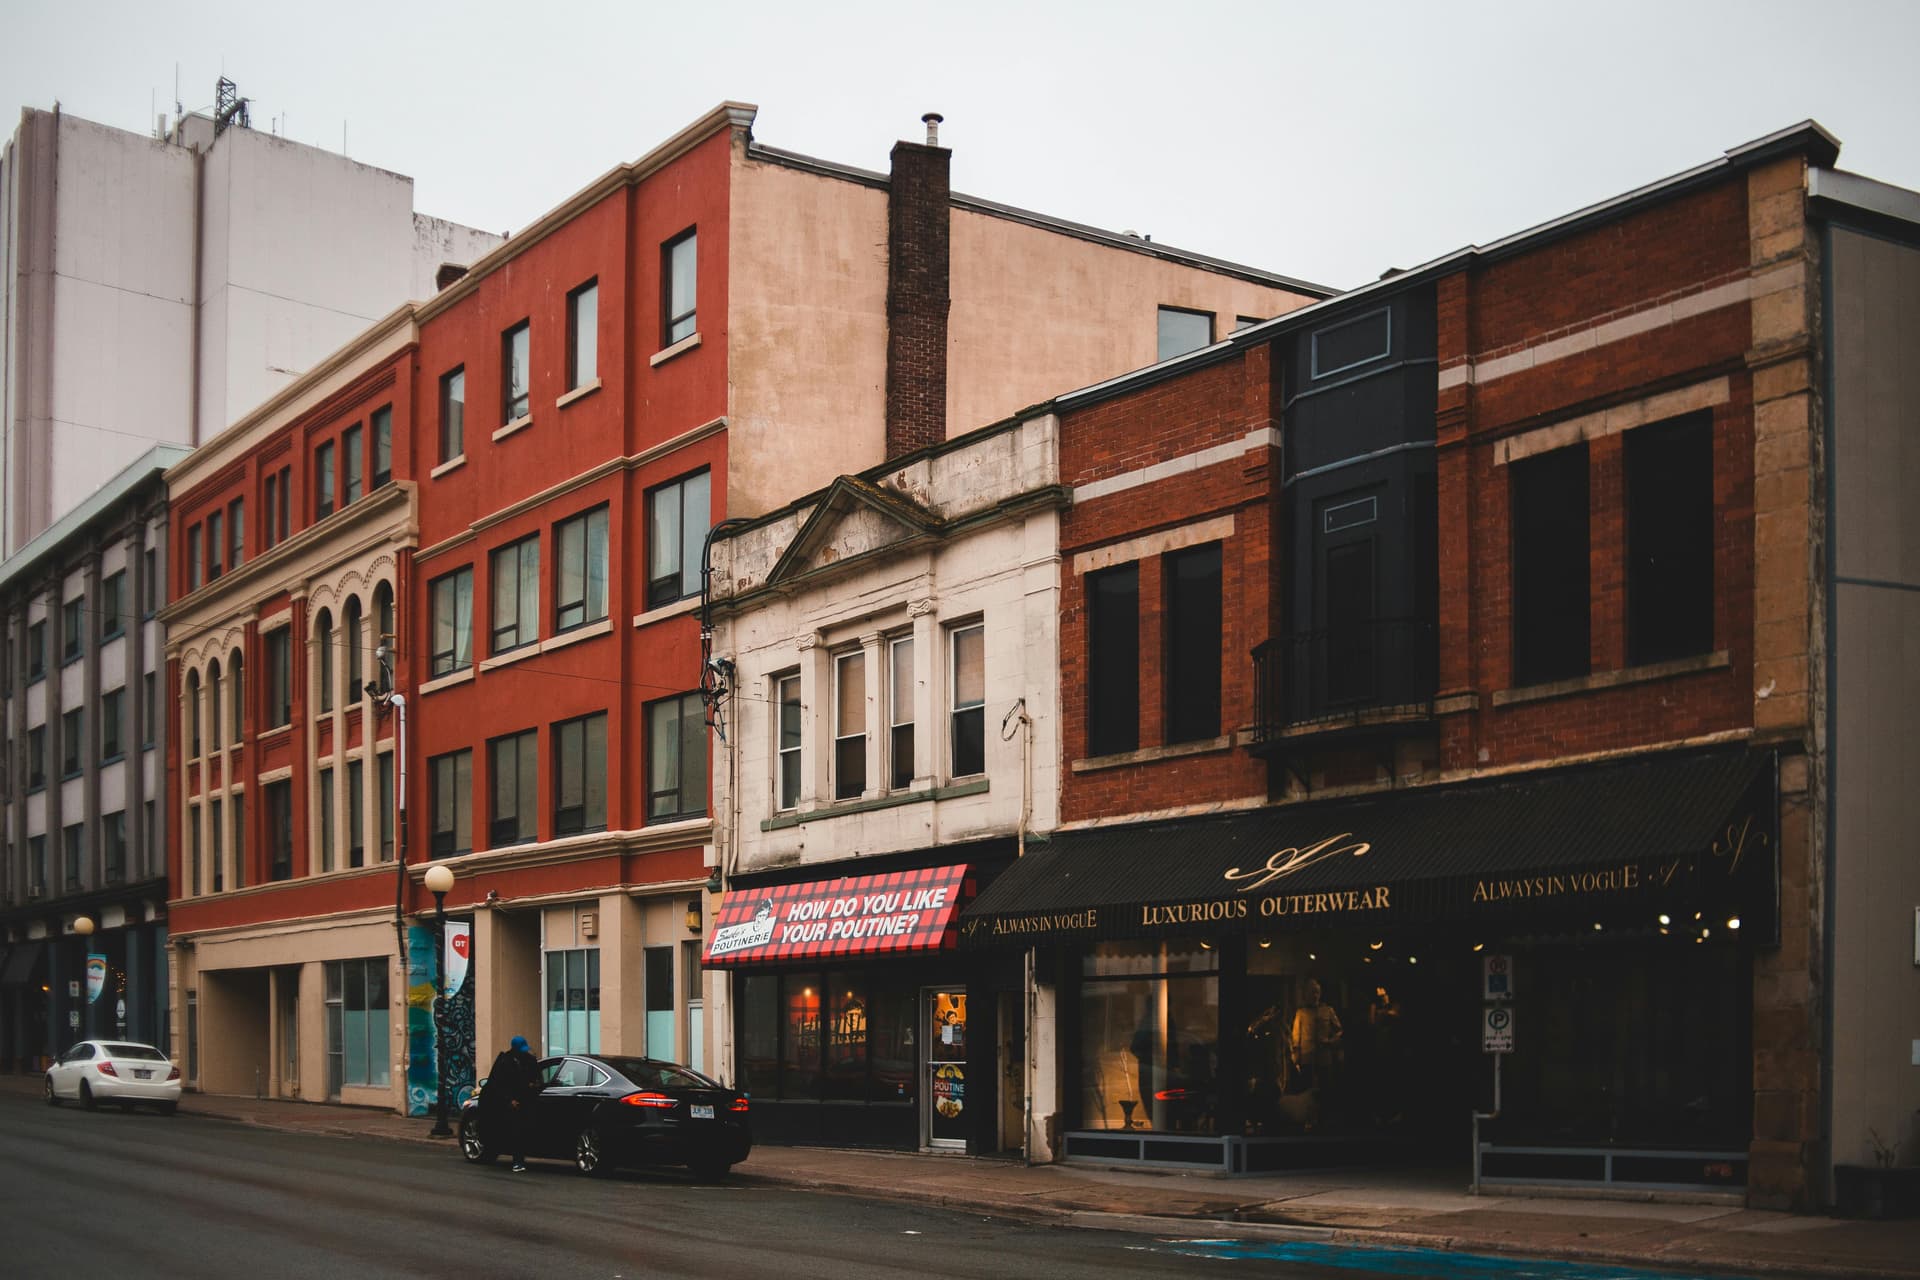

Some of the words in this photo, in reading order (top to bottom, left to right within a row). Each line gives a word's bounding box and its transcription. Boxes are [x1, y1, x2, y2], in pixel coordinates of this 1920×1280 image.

[1473, 876, 1544, 903] ALWAYS
[1547, 875, 1565, 895] IN
[1570, 864, 1639, 893] VOGUE
[787, 899, 831, 922] HOW
[830, 897, 858, 919] DO
[862, 892, 901, 916] YOU
[901, 887, 948, 912] LIKE
[1142, 899, 1247, 926] LUXURIOUS
[1260, 886, 1391, 917] OUTERWEAR
[781, 919, 828, 944] YOUR
[828, 913, 920, 940] POUTINE?
[992, 916, 1039, 935] ALWAYS
[1040, 915, 1052, 932] IN
[1054, 909, 1097, 930] VOGUE
[713, 931, 769, 952] POUTINERIE
[934, 1080, 964, 1093] POUTINE
